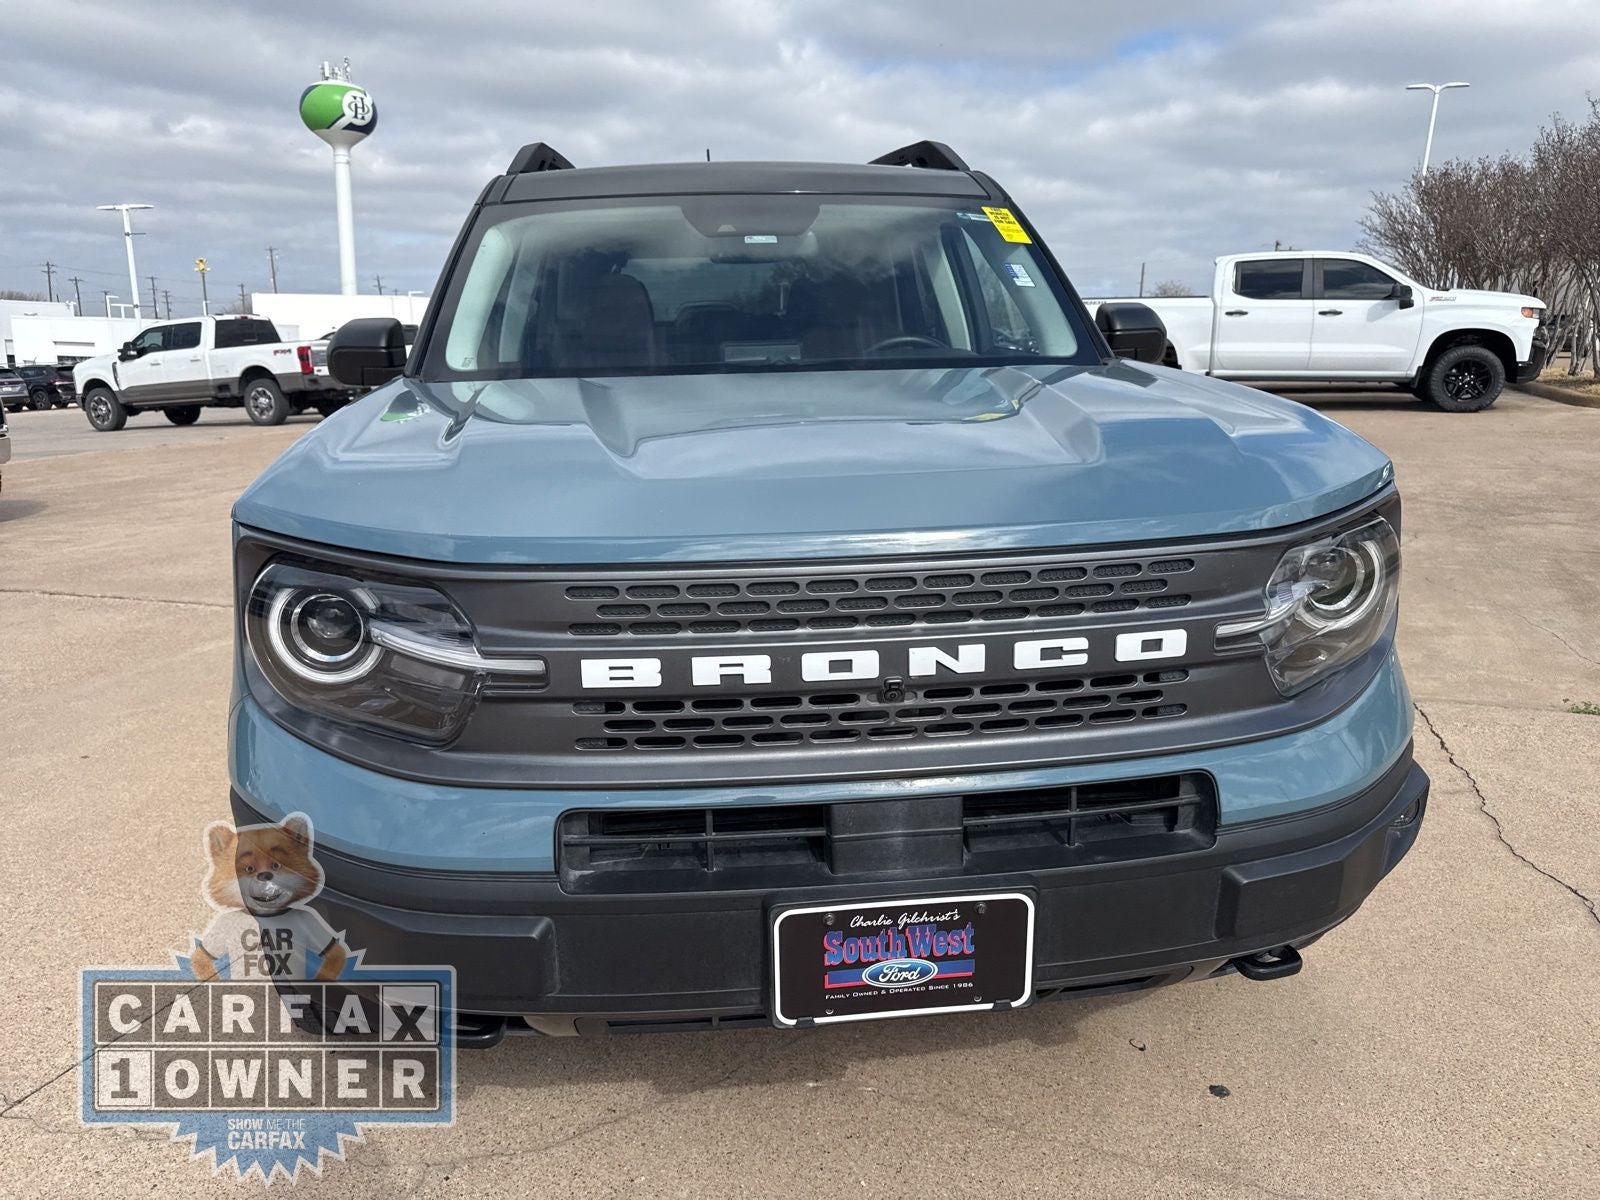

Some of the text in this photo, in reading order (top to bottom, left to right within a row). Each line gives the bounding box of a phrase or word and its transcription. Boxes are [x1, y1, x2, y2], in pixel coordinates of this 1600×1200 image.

[580, 629, 1188, 689] BRONCO
[850, 909, 960, 929] Charlie Gilchrist's
[879, 963, 921, 983] Ford
[825, 991, 850, 1000] FAMILY
[852, 990, 878, 998] OWNED
[889, 986, 926, 995] OPERATED
[928, 983, 949, 991] SINCE
